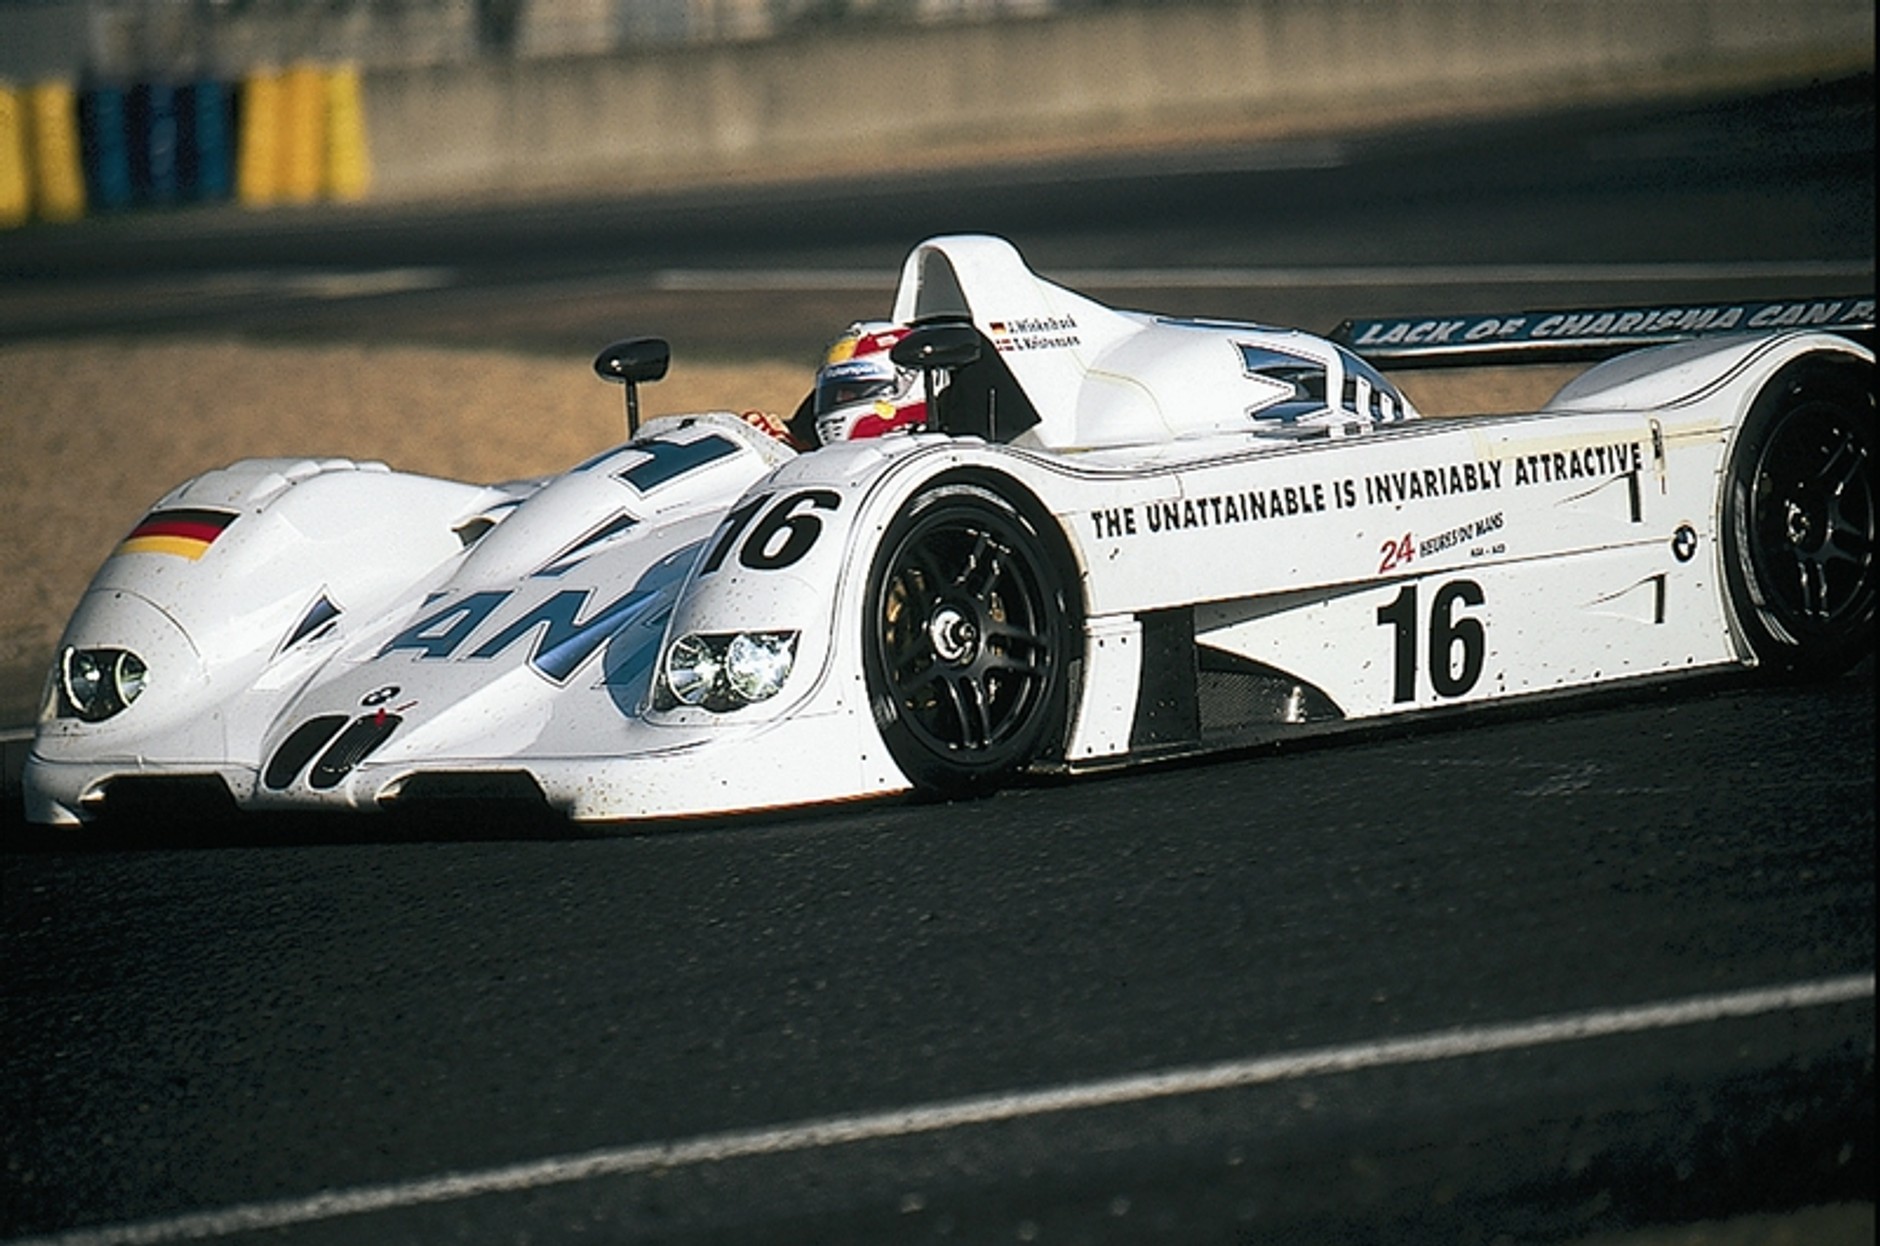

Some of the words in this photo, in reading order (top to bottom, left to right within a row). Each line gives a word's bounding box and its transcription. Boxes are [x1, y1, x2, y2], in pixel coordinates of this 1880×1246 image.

[1355, 321, 1465, 345] LACK
[1463, 317, 1527, 341] OF
[1530, 307, 1744, 337] CHARISMA
[1748, 302, 1842, 327] CAN
[699, 488, 842, 578] 16
[1091, 507, 1136, 539] THE
[1146, 486, 1326, 532] UNATTAINABLE
[1333, 478, 1357, 509] IS
[1365, 459, 1503, 505] INVARIABLY
[1514, 442, 1643, 486] ATTRACTIVE
[1379, 531, 1416, 575] 24
[1377, 579, 1485, 704] 16
